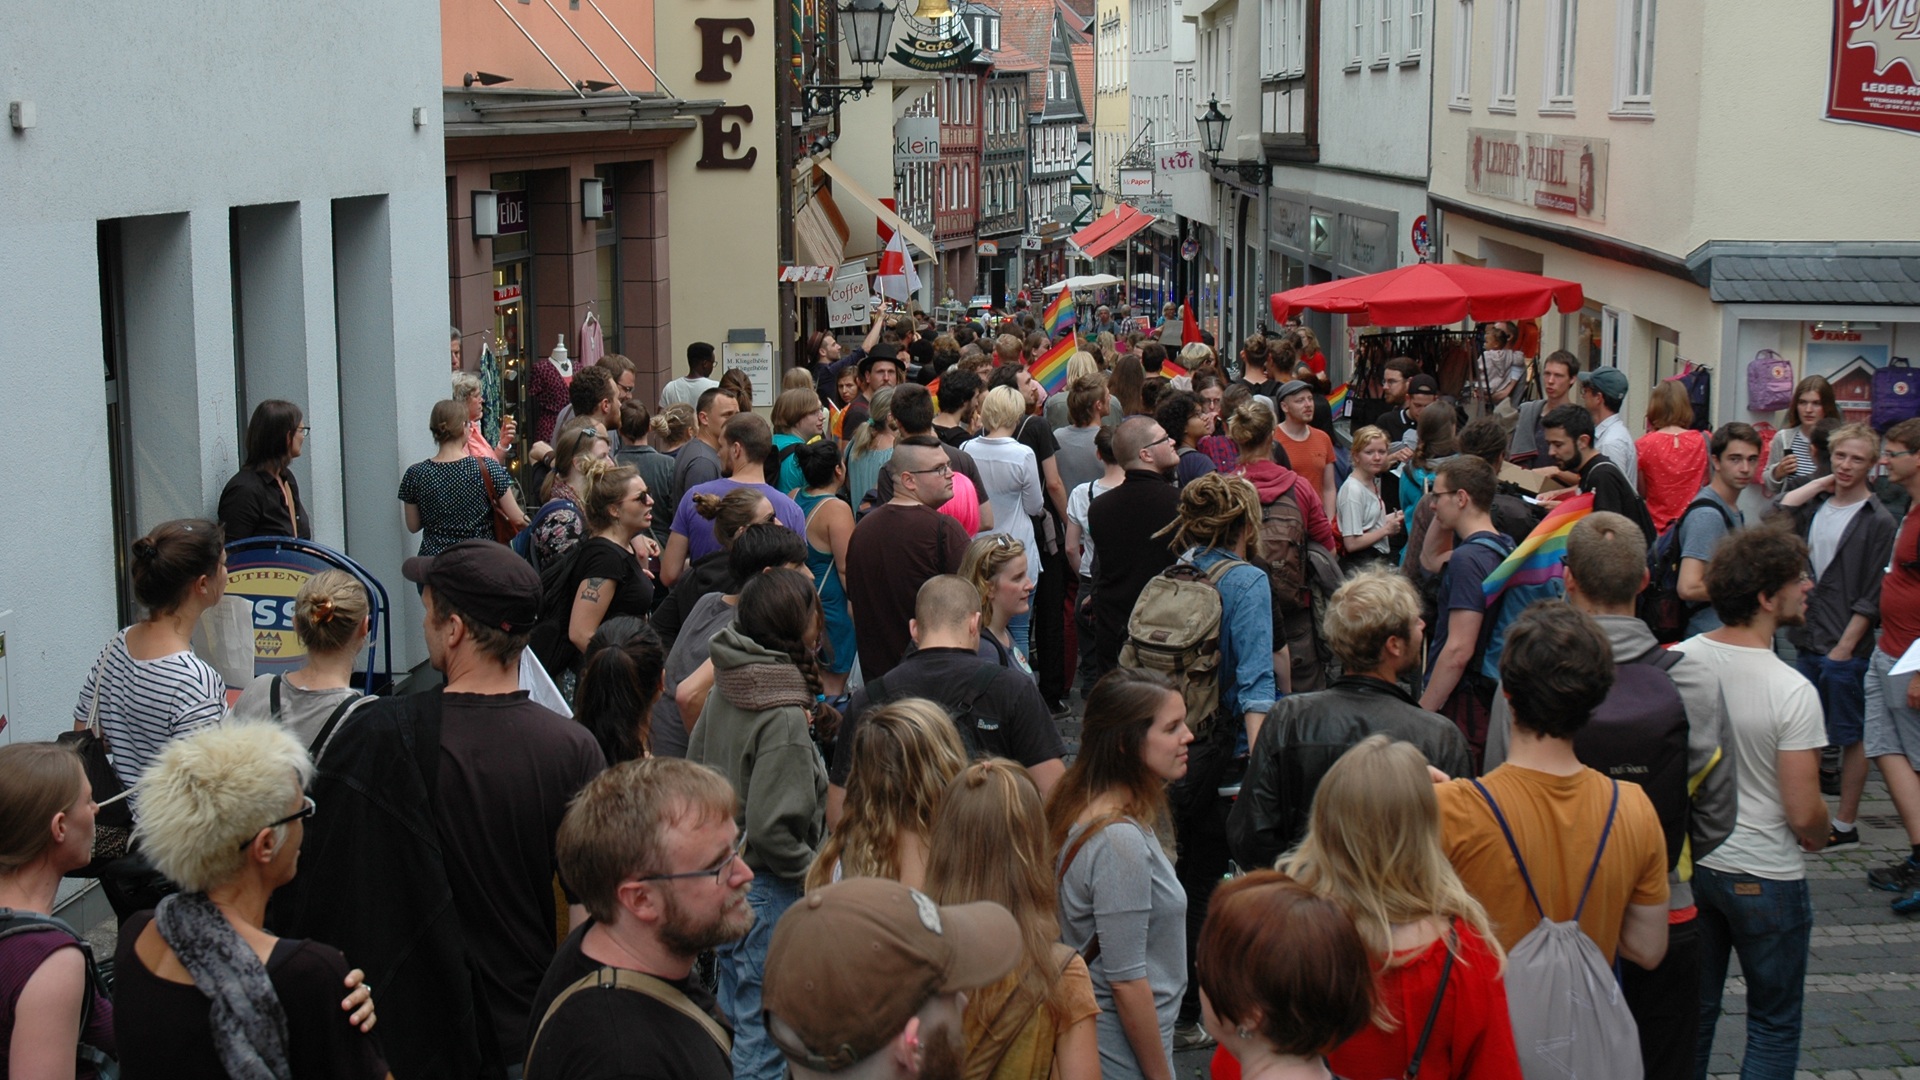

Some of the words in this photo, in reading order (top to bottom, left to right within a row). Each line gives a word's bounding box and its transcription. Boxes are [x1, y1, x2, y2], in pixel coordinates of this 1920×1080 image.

[909, 57, 959, 70] Klingelhöfer
[896, 136, 938, 154] klein
[831, 282, 865, 303] Coffee
[831, 312, 840, 322] to
[841, 313, 852, 325] go
[1825, 333, 1862, 342] RAVEN
